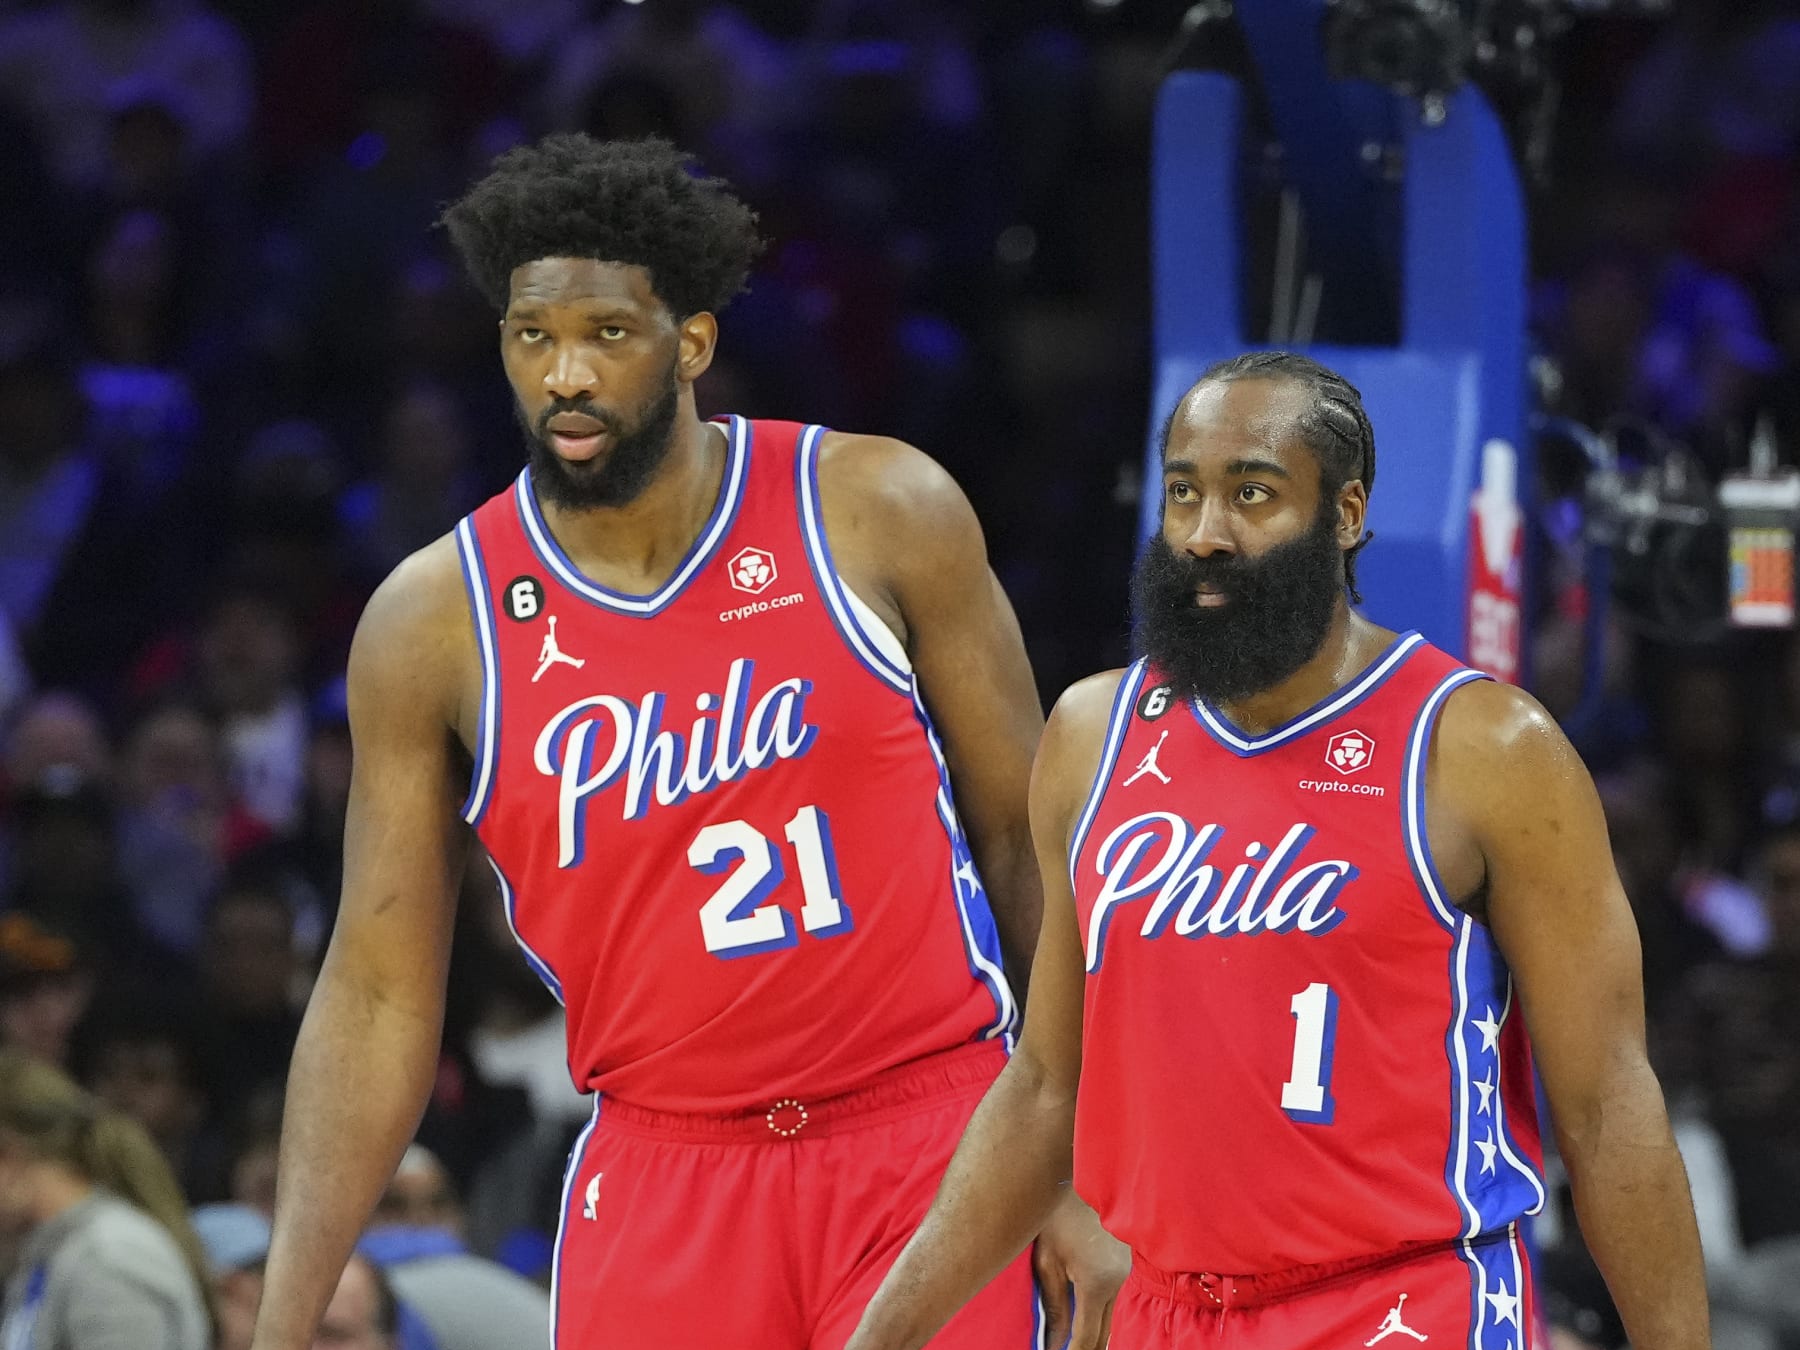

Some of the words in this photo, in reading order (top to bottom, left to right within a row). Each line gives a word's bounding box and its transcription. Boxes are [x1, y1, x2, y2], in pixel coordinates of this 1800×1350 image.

[511, 580, 538, 618] 6
[719, 592, 804, 622] crypto.com
[1144, 686, 1171, 716] 6
[533, 657, 818, 868] Phila
[1298, 779, 1385, 796] crypto.com
[687, 804, 853, 960] 21
[1085, 811, 1360, 975] Phila
[1280, 982, 1340, 1126] 1
